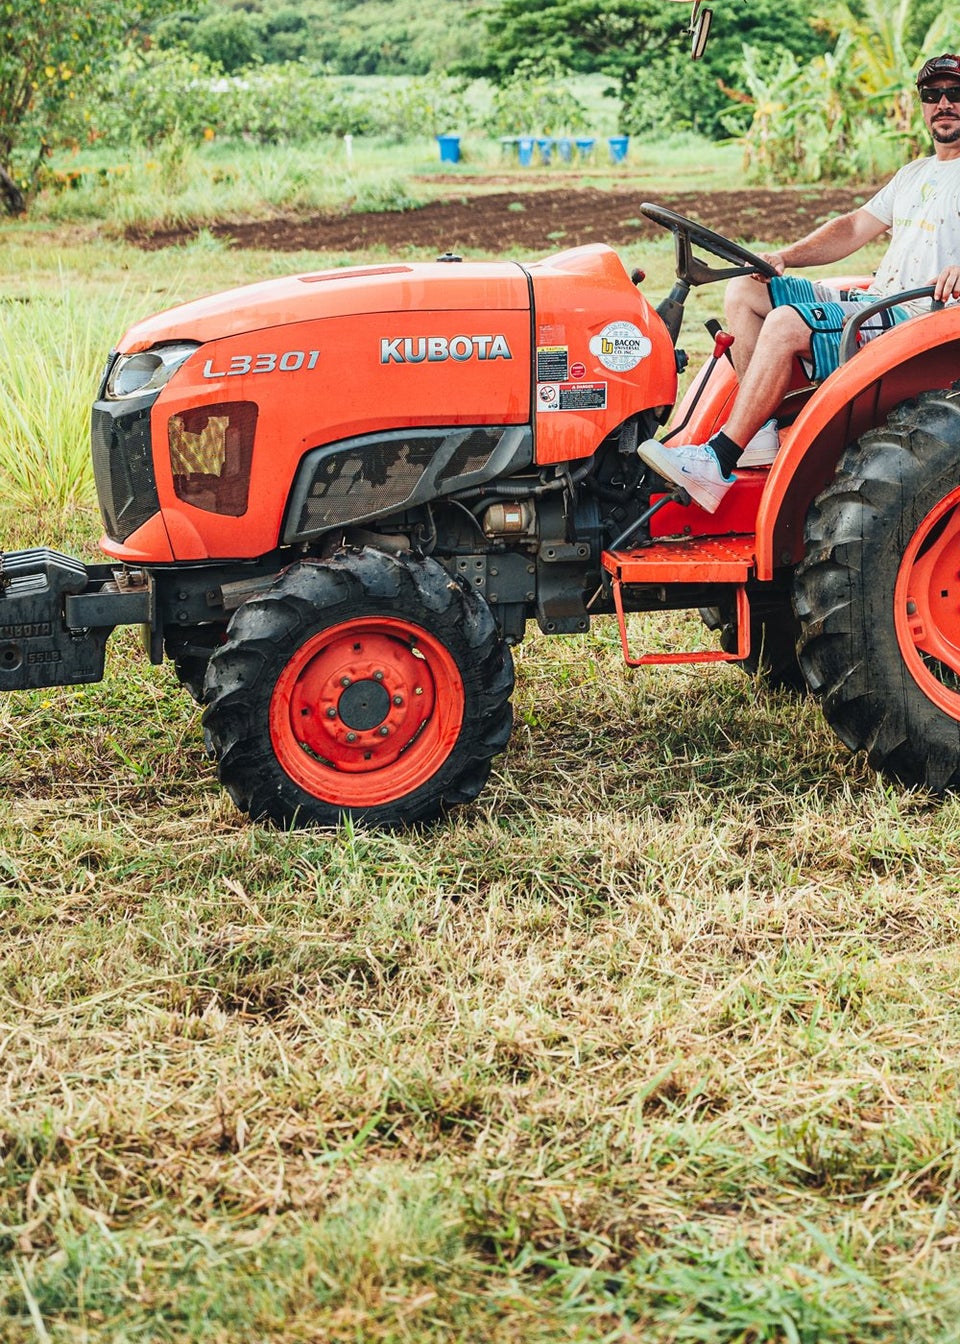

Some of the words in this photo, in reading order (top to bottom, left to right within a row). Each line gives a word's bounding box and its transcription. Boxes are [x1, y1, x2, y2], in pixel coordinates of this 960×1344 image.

[380, 335, 513, 364] KUBOTA
[614, 339, 640, 347] BACON
[202, 350, 321, 378] L3301
